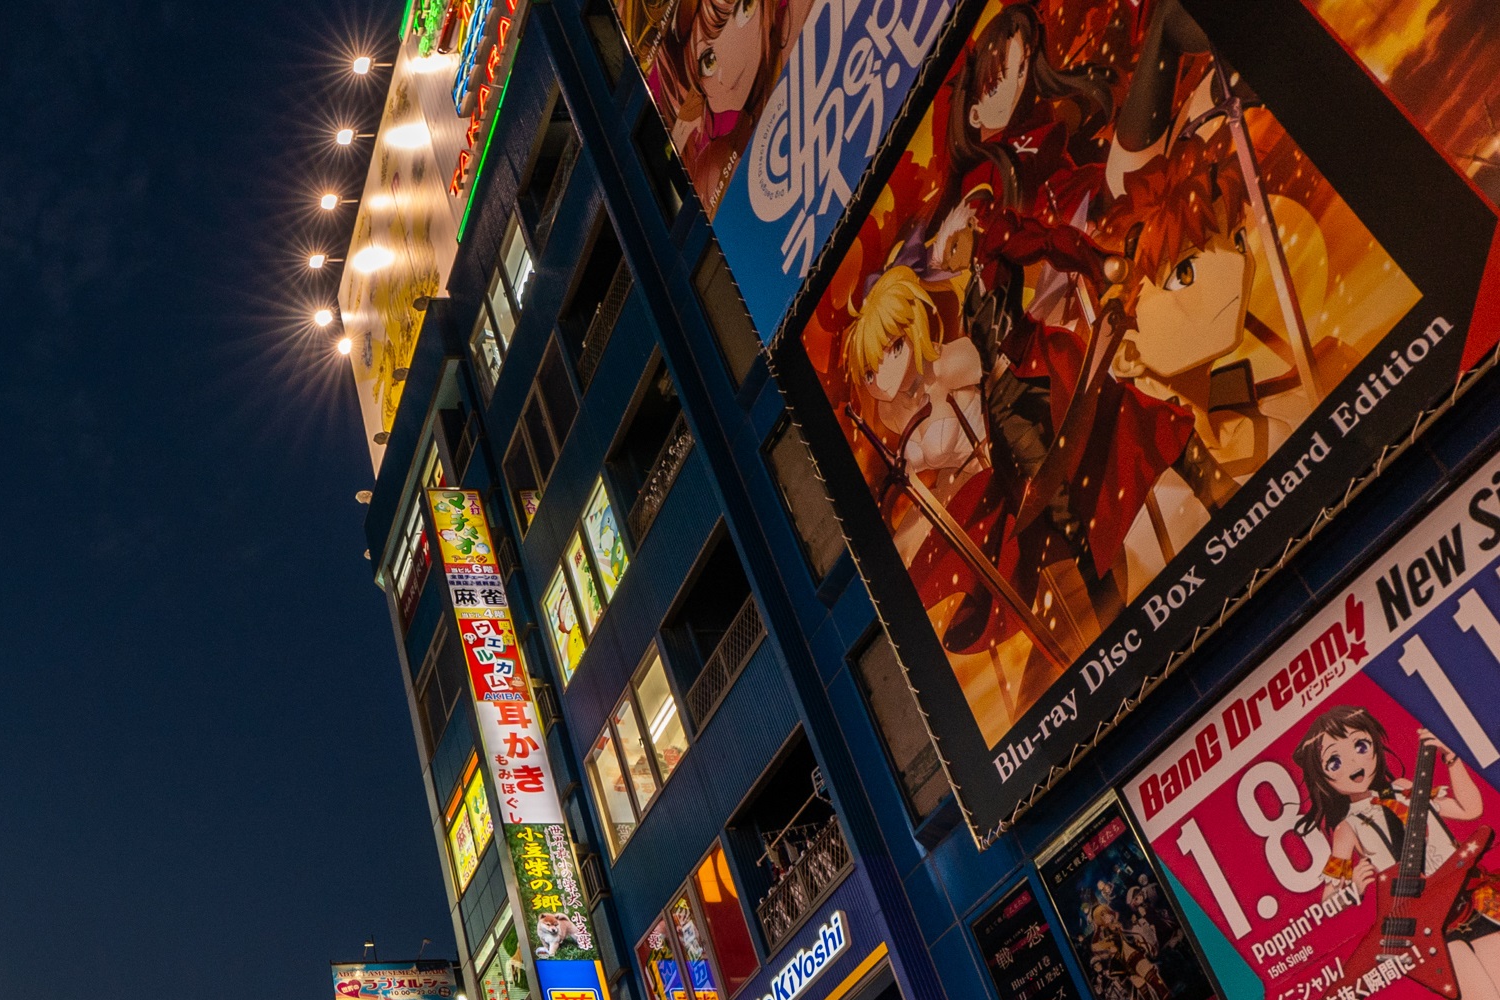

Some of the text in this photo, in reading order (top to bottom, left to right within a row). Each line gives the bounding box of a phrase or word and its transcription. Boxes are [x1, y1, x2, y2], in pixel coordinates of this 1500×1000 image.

[993, 312, 1456, 786] Blu-ray Disc Box Standard Edition
[454, 588, 507, 607] 麻雀
[484, 692, 523, 701] AKIBA
[1137, 738, 1221, 822] BanG
[1375, 522, 1466, 633] New
[492, 700, 545, 794] 耳かき
[495, 754, 524, 825] もみほぐし
[516, 827, 562, 913] 小豆柴の郷
[1176, 760, 1334, 941] 1.8
[1251, 880, 1363, 965] Poppin'Party
[1266, 943, 1315, 981] 15th Single
[363, 979, 449, 990] ラブメルシー
